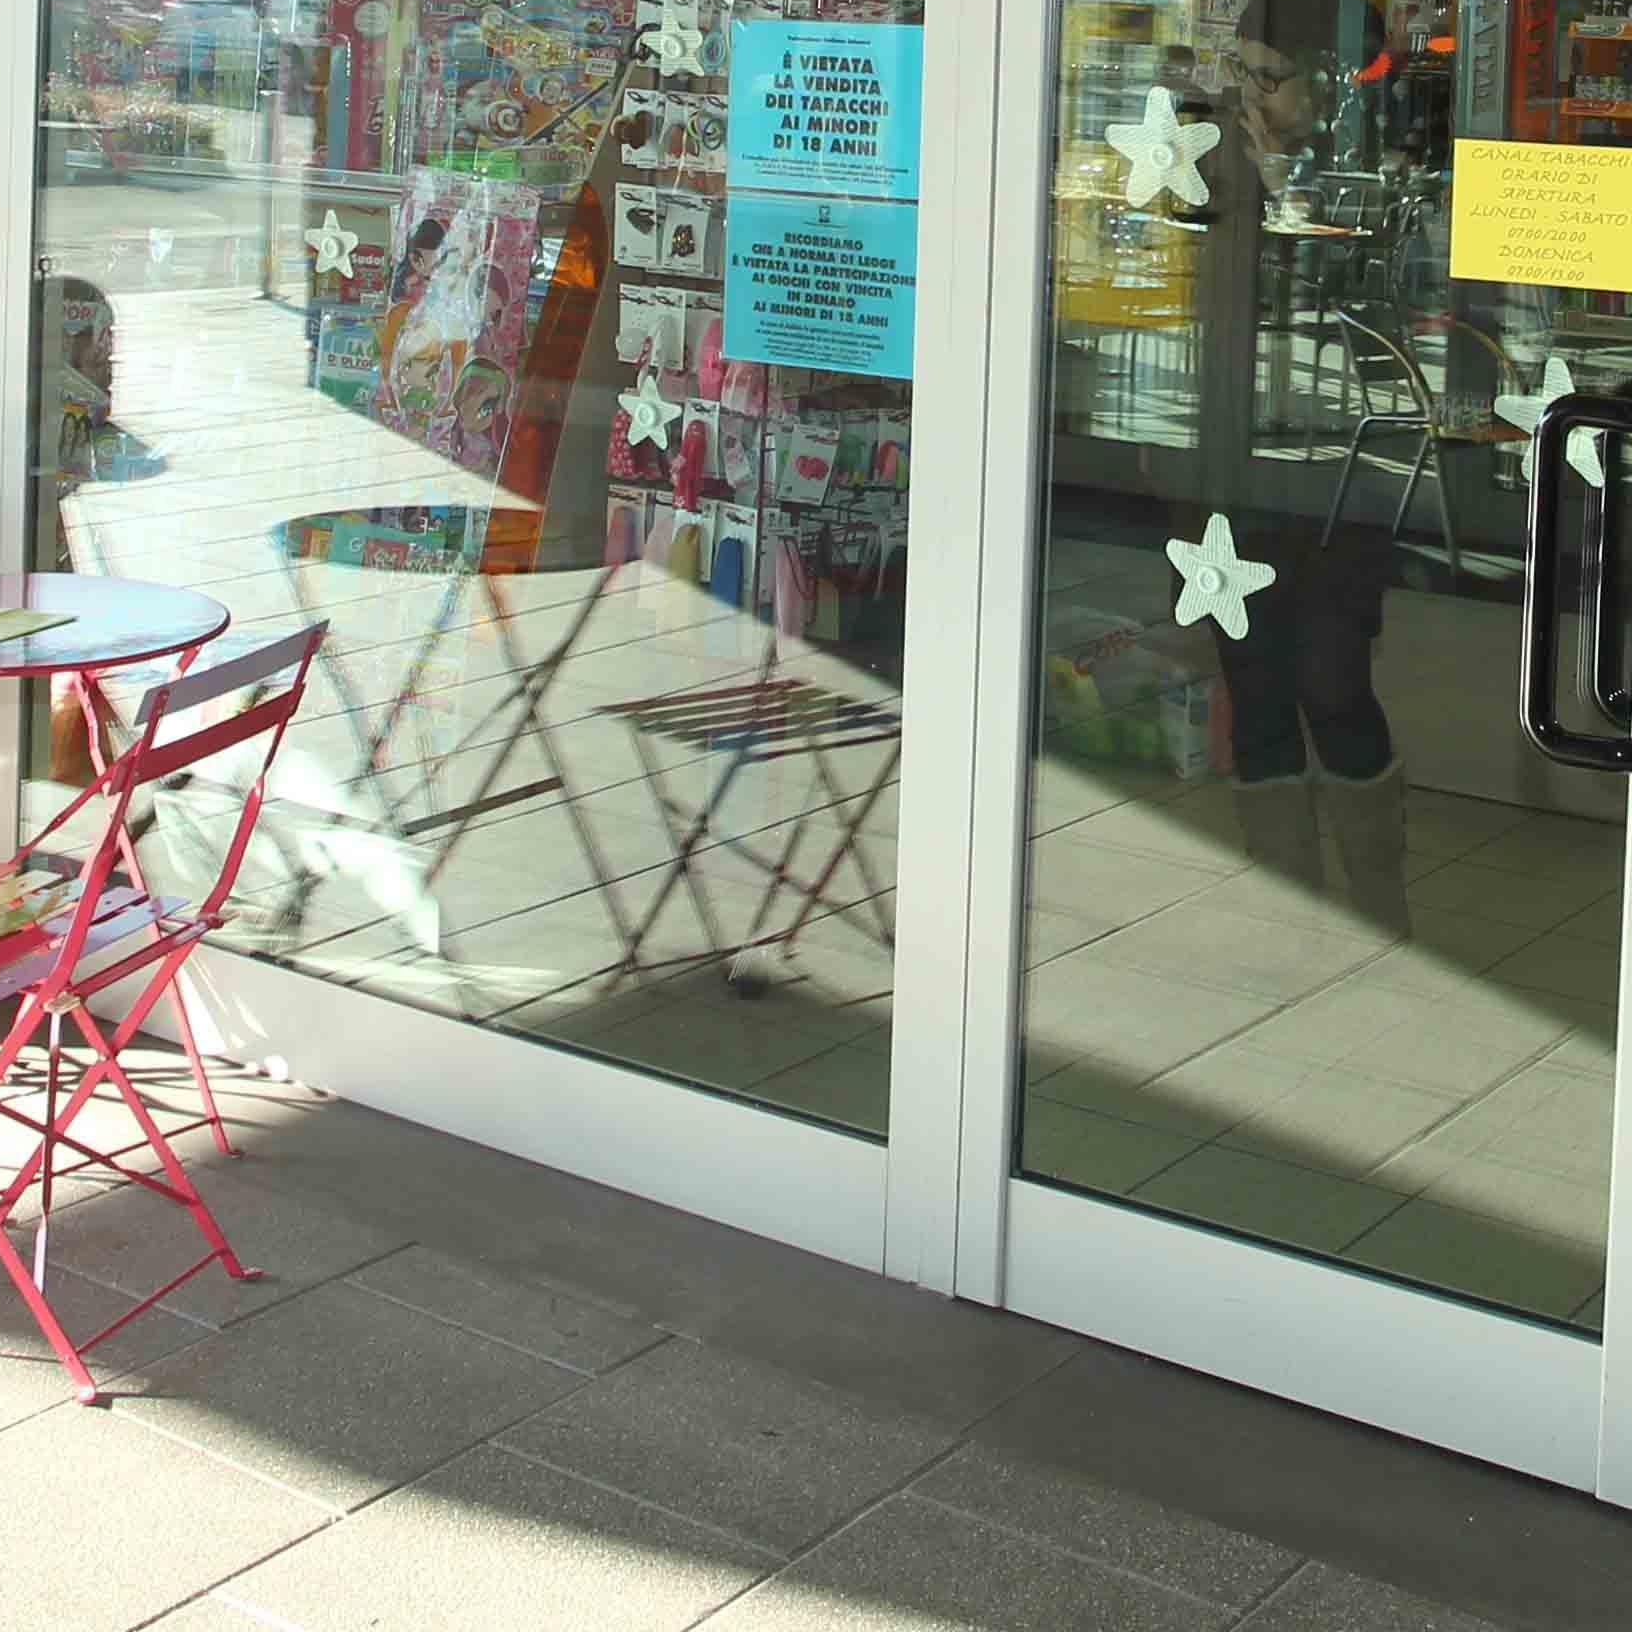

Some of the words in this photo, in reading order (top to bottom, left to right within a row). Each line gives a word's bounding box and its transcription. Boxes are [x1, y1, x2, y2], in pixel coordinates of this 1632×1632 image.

[800, 55, 873, 74] VIETATA
[774, 74, 794, 89] LA
[803, 76, 881, 95] VENDITA
[765, 94, 792, 109] DEI
[801, 96, 889, 115] TABACCHI
[781, 115, 800, 130] AI
[808, 116, 878, 136] MINORI
[773, 135, 791, 150] DI
[801, 137, 821, 152] 18
[830, 139, 877, 156] ANNI
[1472, 147, 1535, 163] CANAL
[1539, 151, 1630, 168] TABACCHI
[1502, 168, 1569, 184] ORARIO
[1576, 172, 1597, 185] DI
[1499, 188, 1597, 205] APERTURA
[1558, 210, 1629, 226] SABATO
[784, 232, 863, 251] RICORDIAMO
[752, 243, 772, 255] CHE
[790, 248, 835, 263] NORMA
[840, 253, 854, 265] DI
[859, 256, 896, 269] LEGGE
[1498, 244, 1594, 263] DOMENICA
[743, 257, 789, 272] VIETATA
[794, 263, 808, 274] LA
[769, 274, 809, 288] GIOCHI
[815, 279, 840, 291] CON
[846, 283, 892, 299] VINCITA
[770, 303, 816, 319] MINORI
[820, 308, 832, 320] DI
[840, 311, 854, 323] 18
[858, 314, 888, 328] ANNI
